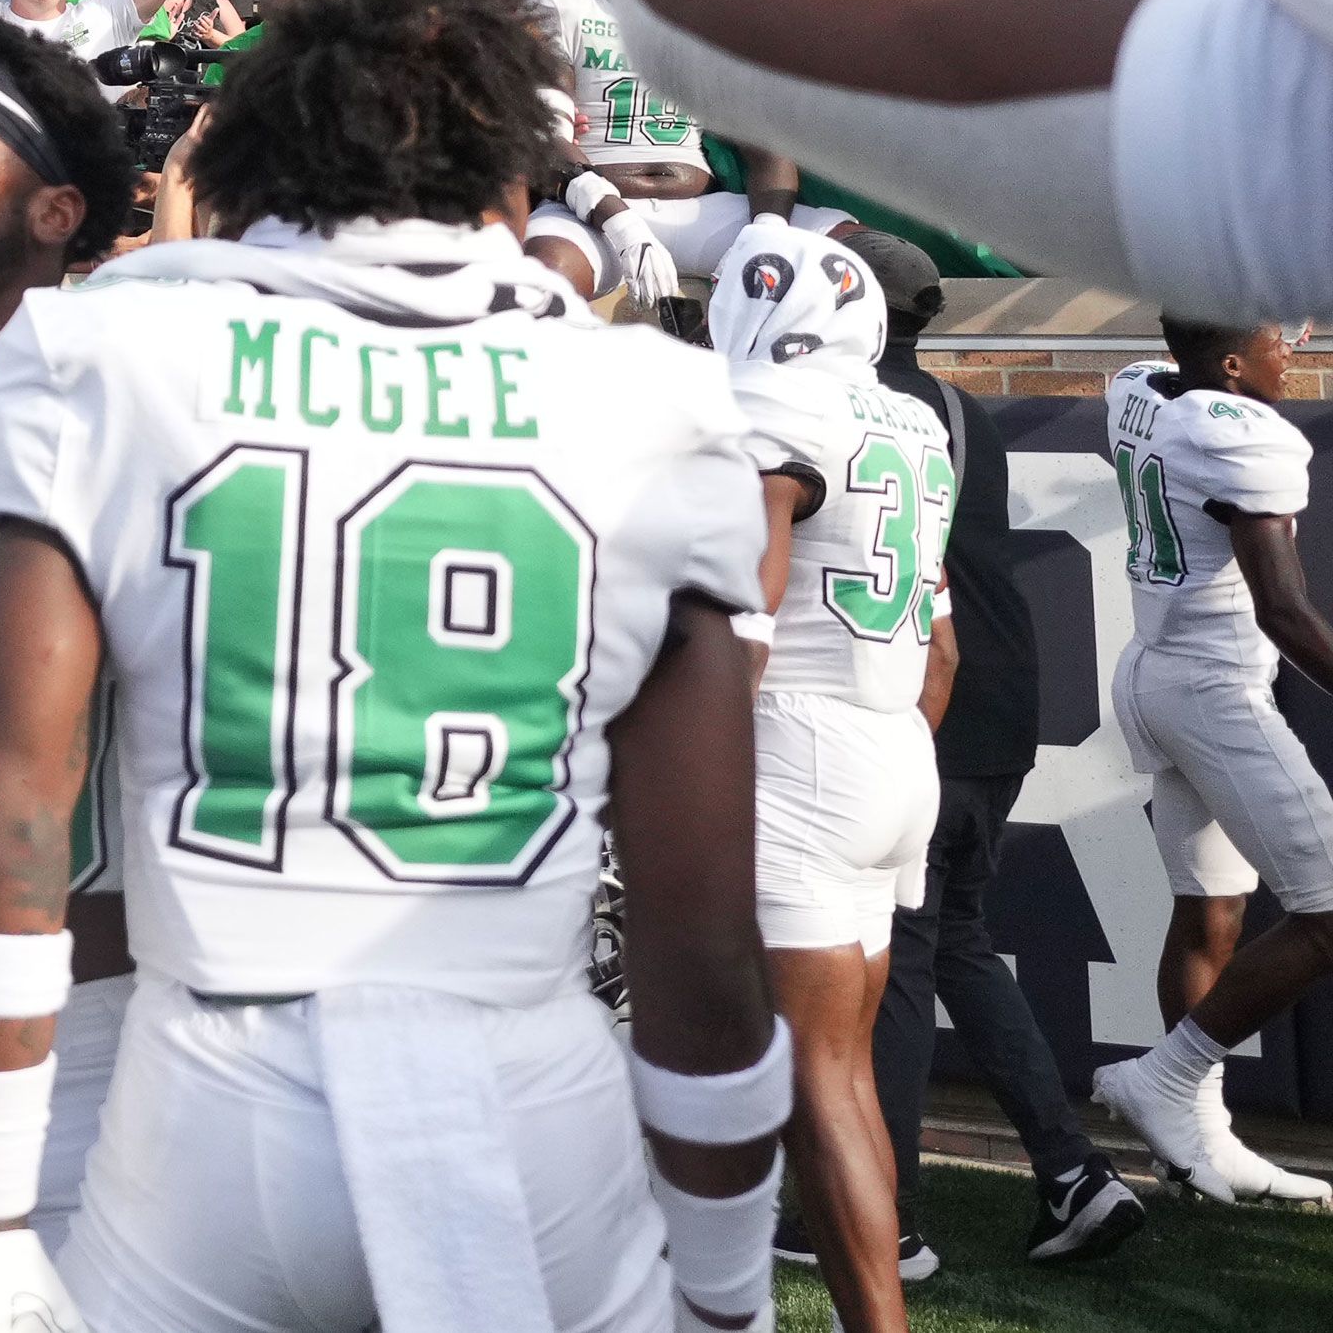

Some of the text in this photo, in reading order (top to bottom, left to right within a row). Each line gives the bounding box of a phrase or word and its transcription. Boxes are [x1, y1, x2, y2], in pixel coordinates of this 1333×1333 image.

[225, 319, 539, 440] MCGEE
[1118, 393, 1162, 442] HILL
[164, 442, 598, 886] 18
